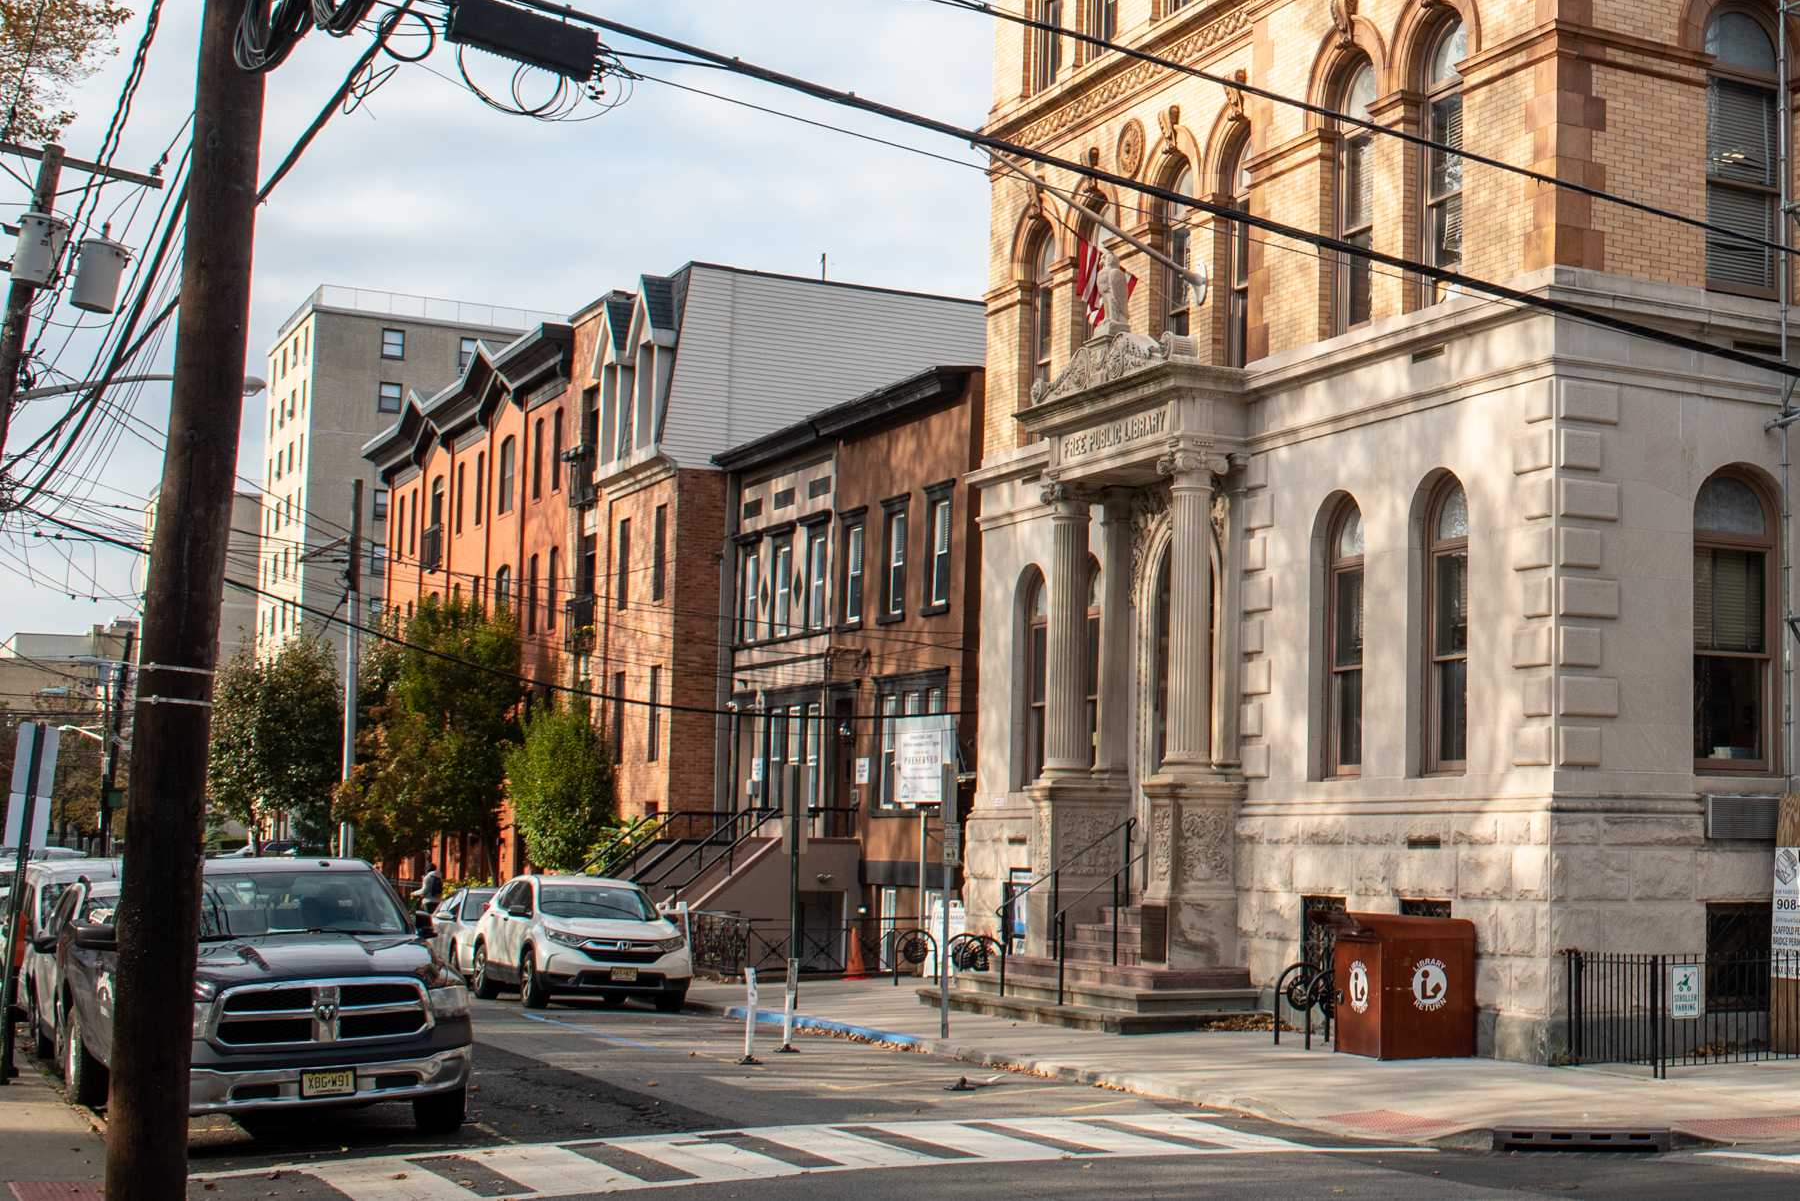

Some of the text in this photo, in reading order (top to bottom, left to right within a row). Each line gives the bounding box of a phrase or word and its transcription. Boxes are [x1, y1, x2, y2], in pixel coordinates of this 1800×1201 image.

[1063, 410, 1166, 459] FREE PUBLIC LIBRARY
[904, 755, 939, 765] PRESERVED
[1772, 925, 1794, 935] SCAFFOLD
[1772, 936, 1788, 946] BRIDGE
[1412, 958, 1447, 972] LIBRARY
[1674, 994, 1698, 1003] STROLLER
[1413, 997, 1447, 1012] RETURN
[1675, 1003, 1697, 1012] PARKING
